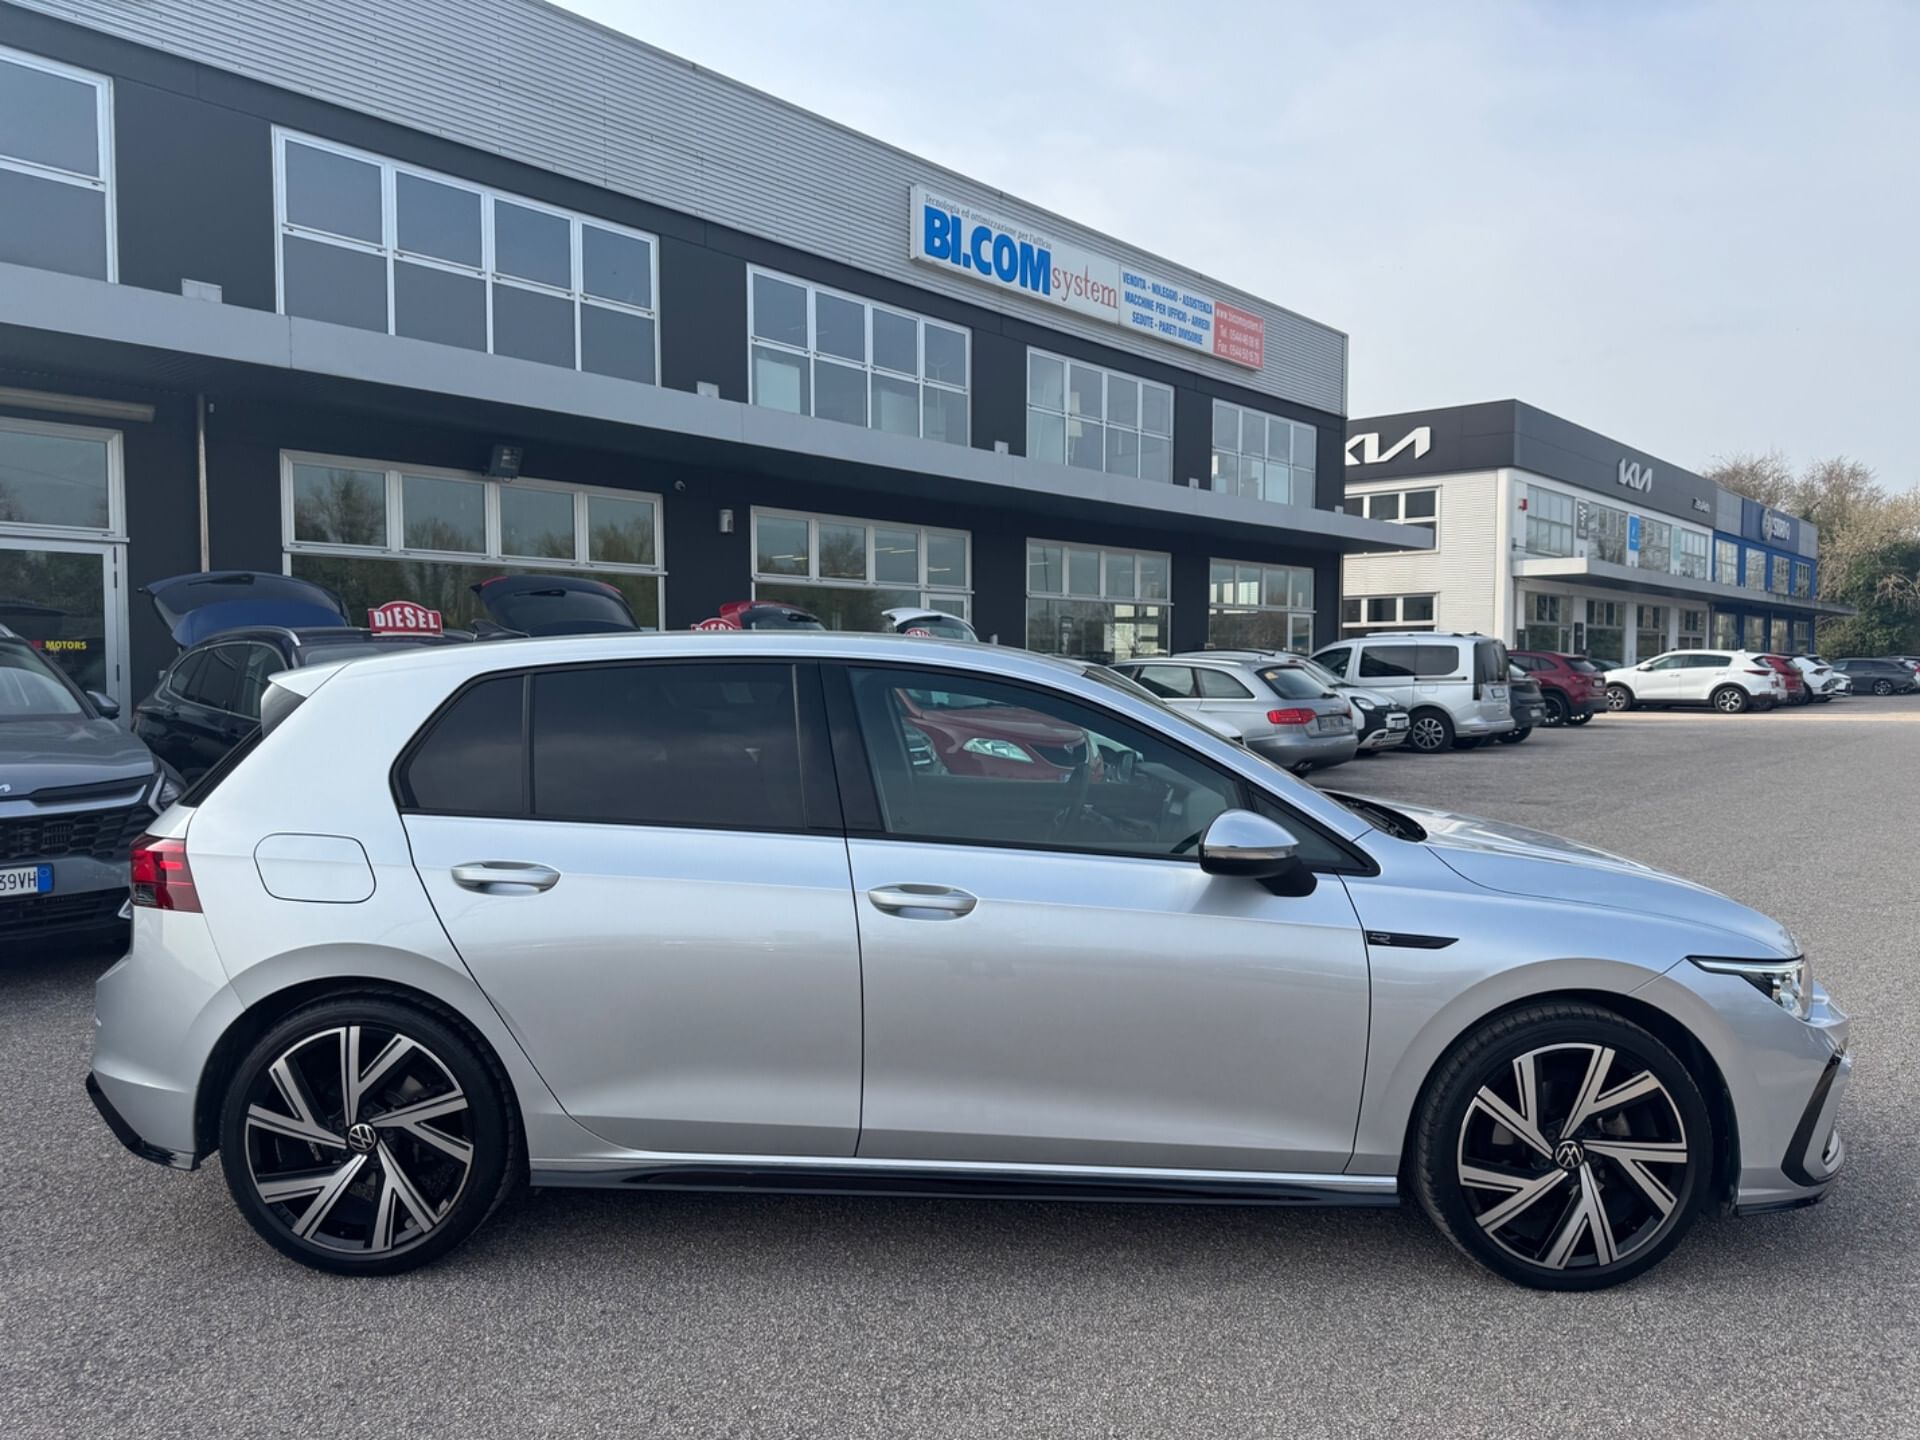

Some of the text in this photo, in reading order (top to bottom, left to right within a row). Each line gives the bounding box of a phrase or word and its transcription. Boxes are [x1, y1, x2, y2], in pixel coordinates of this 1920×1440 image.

[924, 205, 1118, 310] BI.COM system
[1123, 272, 1146, 290] VENDITA
[1151, 283, 1178, 302] NOLEGGIO
[1182, 295, 1212, 314] ASSISTENZA
[1124, 291, 1154, 311] MACCHINE
[1155, 302, 1165, 315] PER
[1167, 307, 1186, 322] UFFICIO
[1618, 458, 1653, 493] KIA
[373, 606, 438, 629] DIESEL
[45, 640, 87, 650] MOTORS
